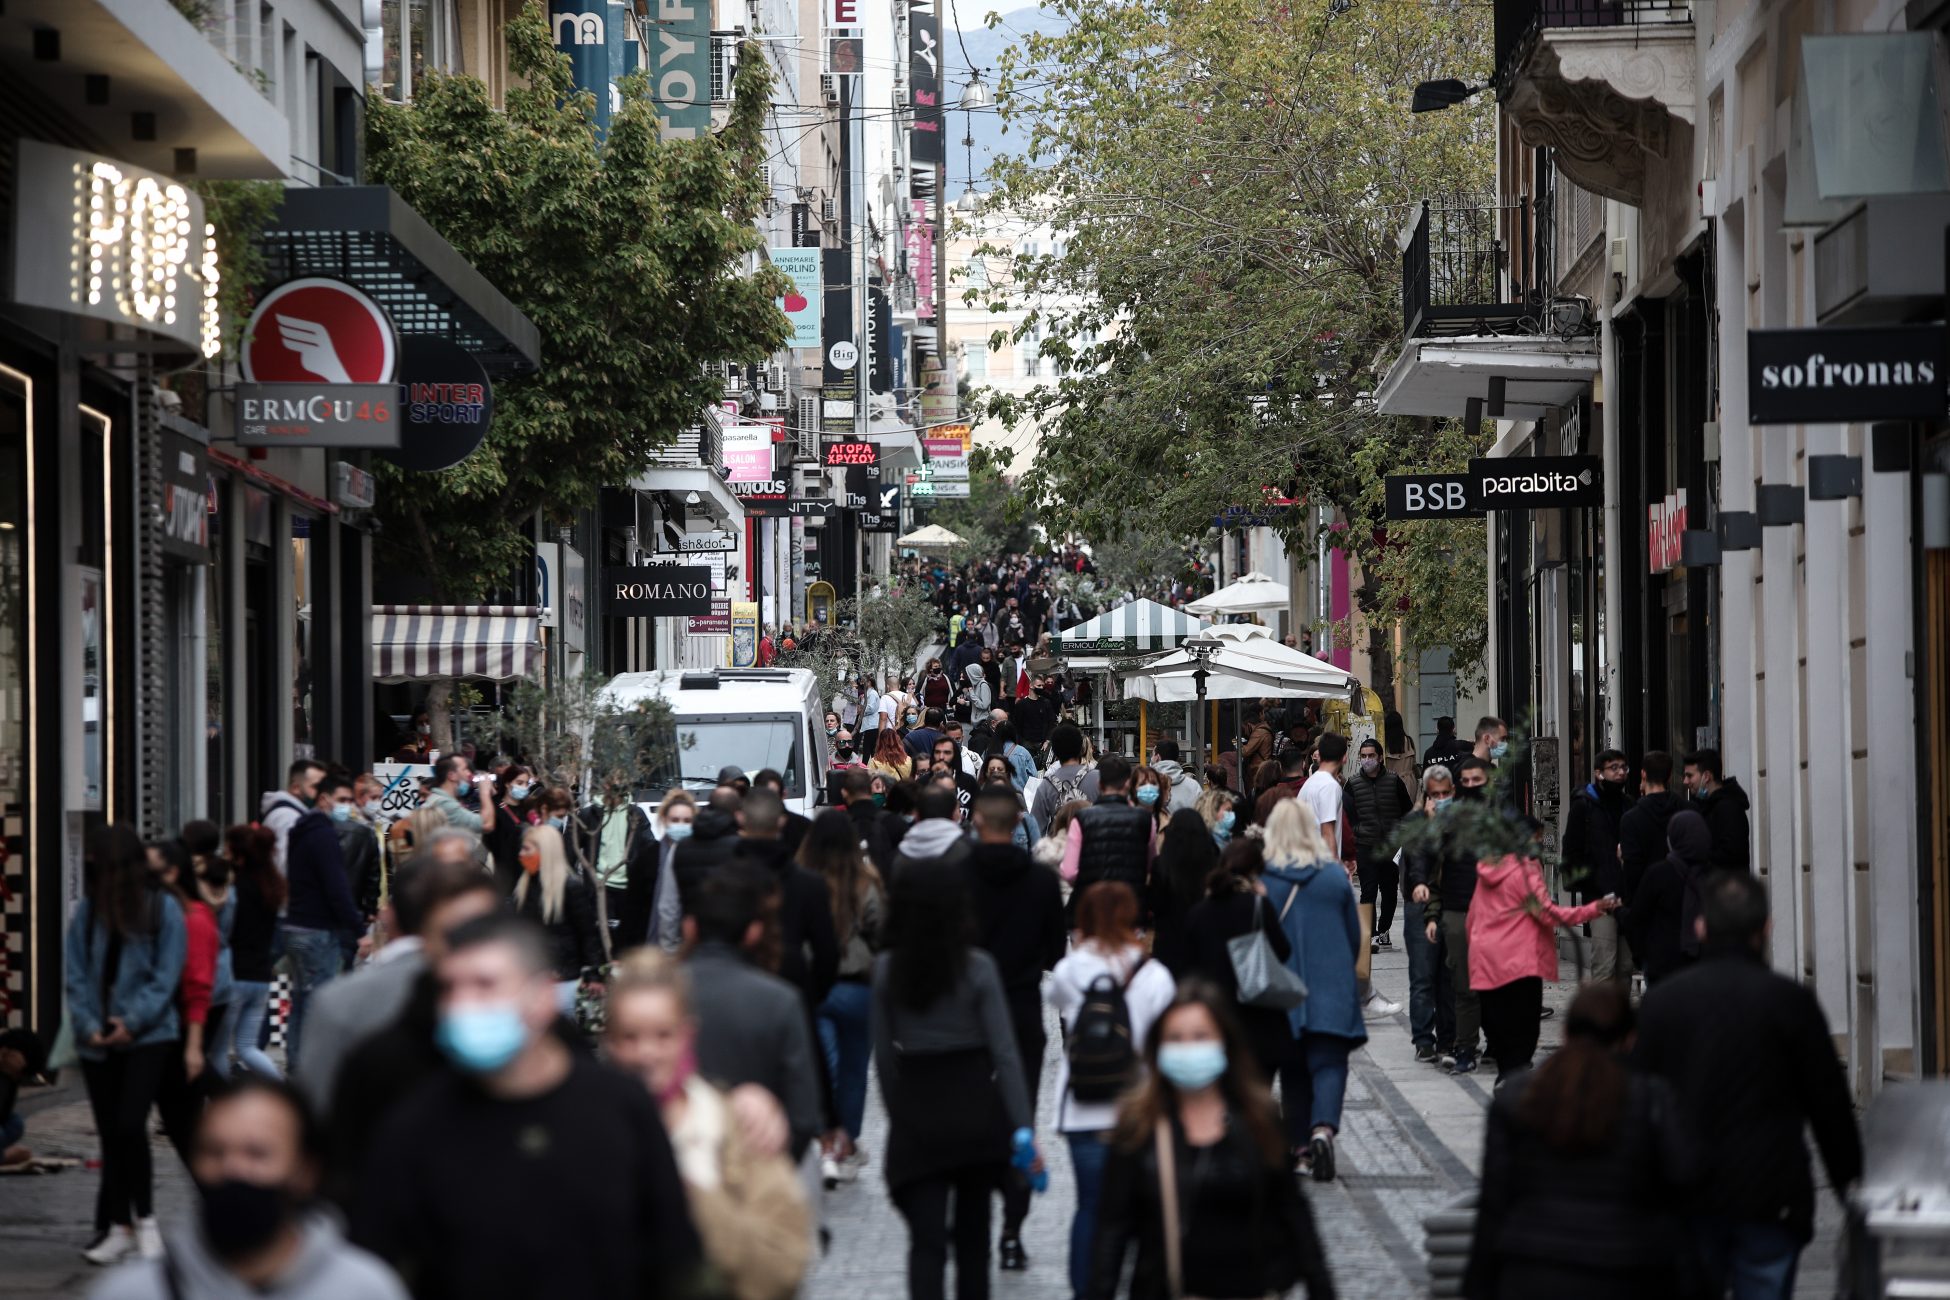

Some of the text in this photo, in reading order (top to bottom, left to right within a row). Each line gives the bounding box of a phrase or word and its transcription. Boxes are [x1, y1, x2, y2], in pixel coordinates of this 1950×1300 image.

[868, 297, 877, 375] SEPHORA
[833, 349, 854, 360] Big
[1762, 353, 1935, 389] sofronas
[410, 382, 485, 403] INTER
[355, 400, 391, 423] 46
[410, 403, 483, 424] SPORT
[722, 434, 758, 442] pasarella
[830, 444, 873, 454] ΑΓΟΡΑ
[730, 454, 756, 464] SALON
[827, 454, 876, 464] ΧΡΥΣΟΥ
[1482, 471, 1578, 497] parabita
[845, 492, 866, 505] Ths
[1405, 483, 1466, 511] BSB
[860, 512, 880, 524] Ths
[615, 583, 708, 600] ROMANO
[1094, 638, 1125, 649] Flower
[1428, 754, 1458, 764] EPLA
